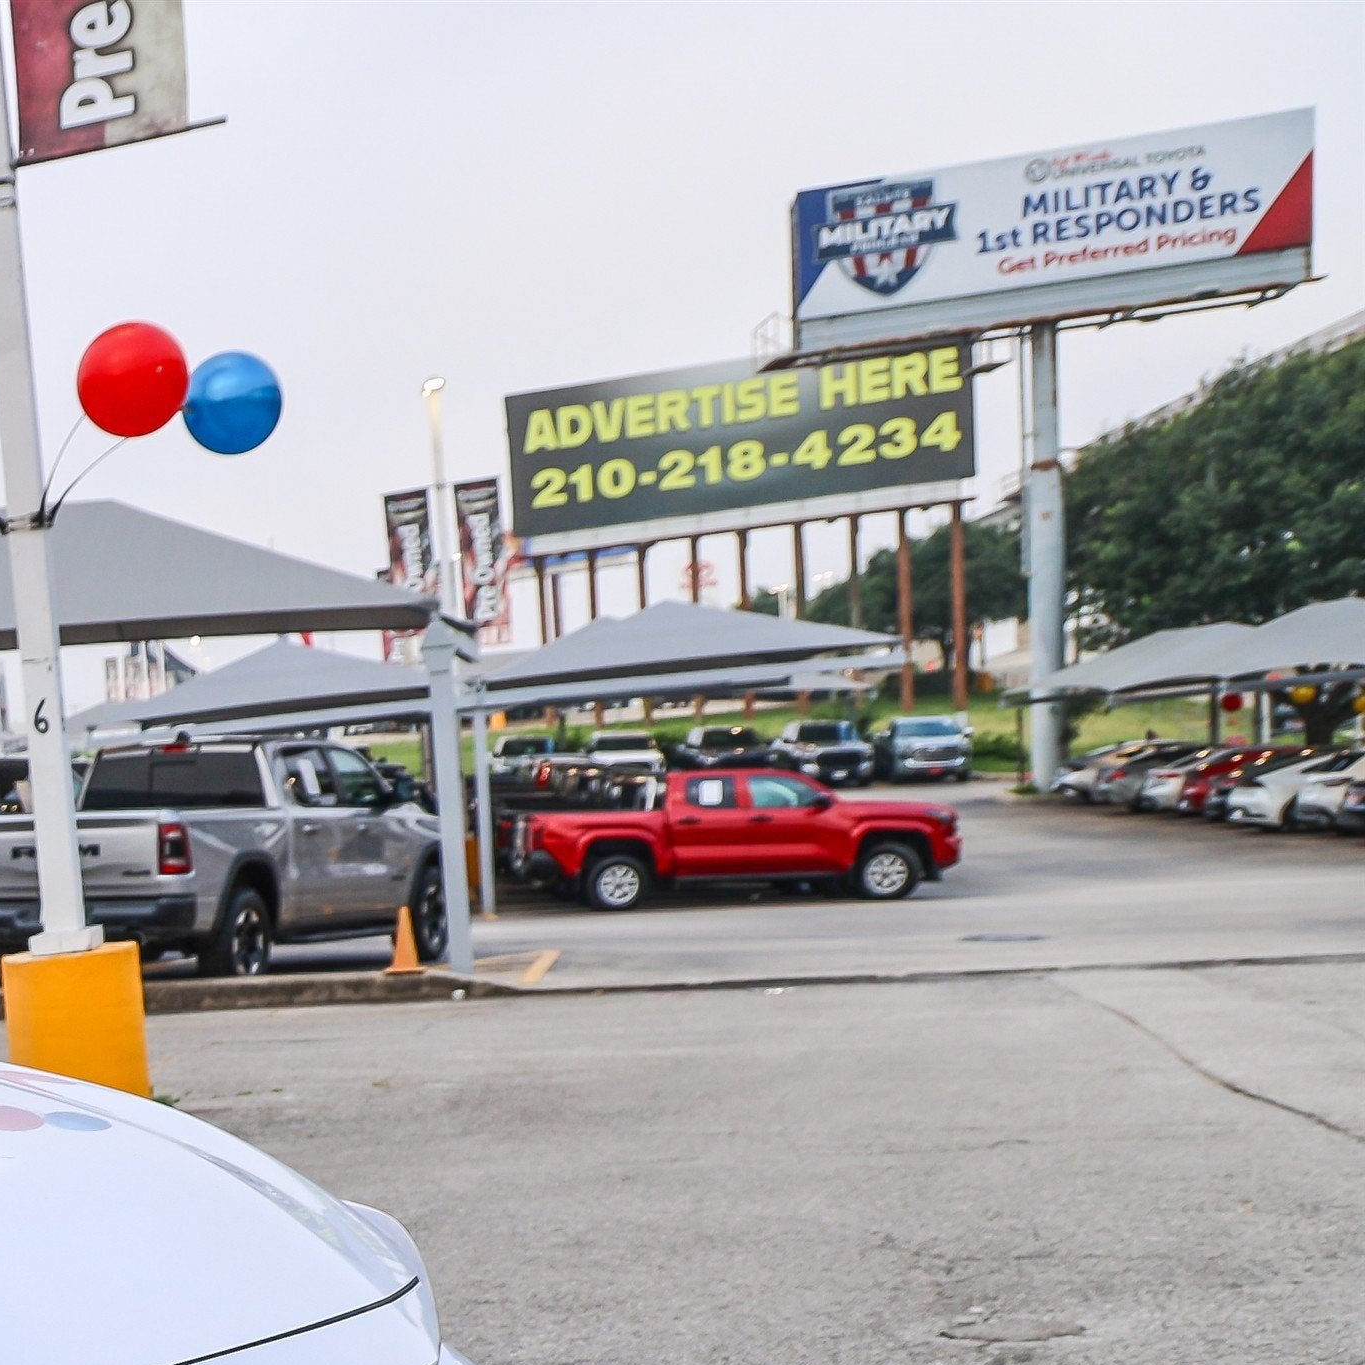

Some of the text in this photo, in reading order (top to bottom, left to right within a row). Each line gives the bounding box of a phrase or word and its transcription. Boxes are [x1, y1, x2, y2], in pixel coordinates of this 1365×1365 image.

[59, 0, 137, 130] Pre
[1022, 167, 1213, 218] MILITARY &
[819, 206, 952, 249] MILITARY
[977, 187, 1261, 254] 1st RESPONDERS
[997, 227, 1239, 276] Get Preferred Pricing
[523, 346, 964, 454] ADVERTISE HERE
[530, 411, 963, 510] 210-218-4234
[34, 697, 49, 734] 6
[12, 844, 100, 858] RM
